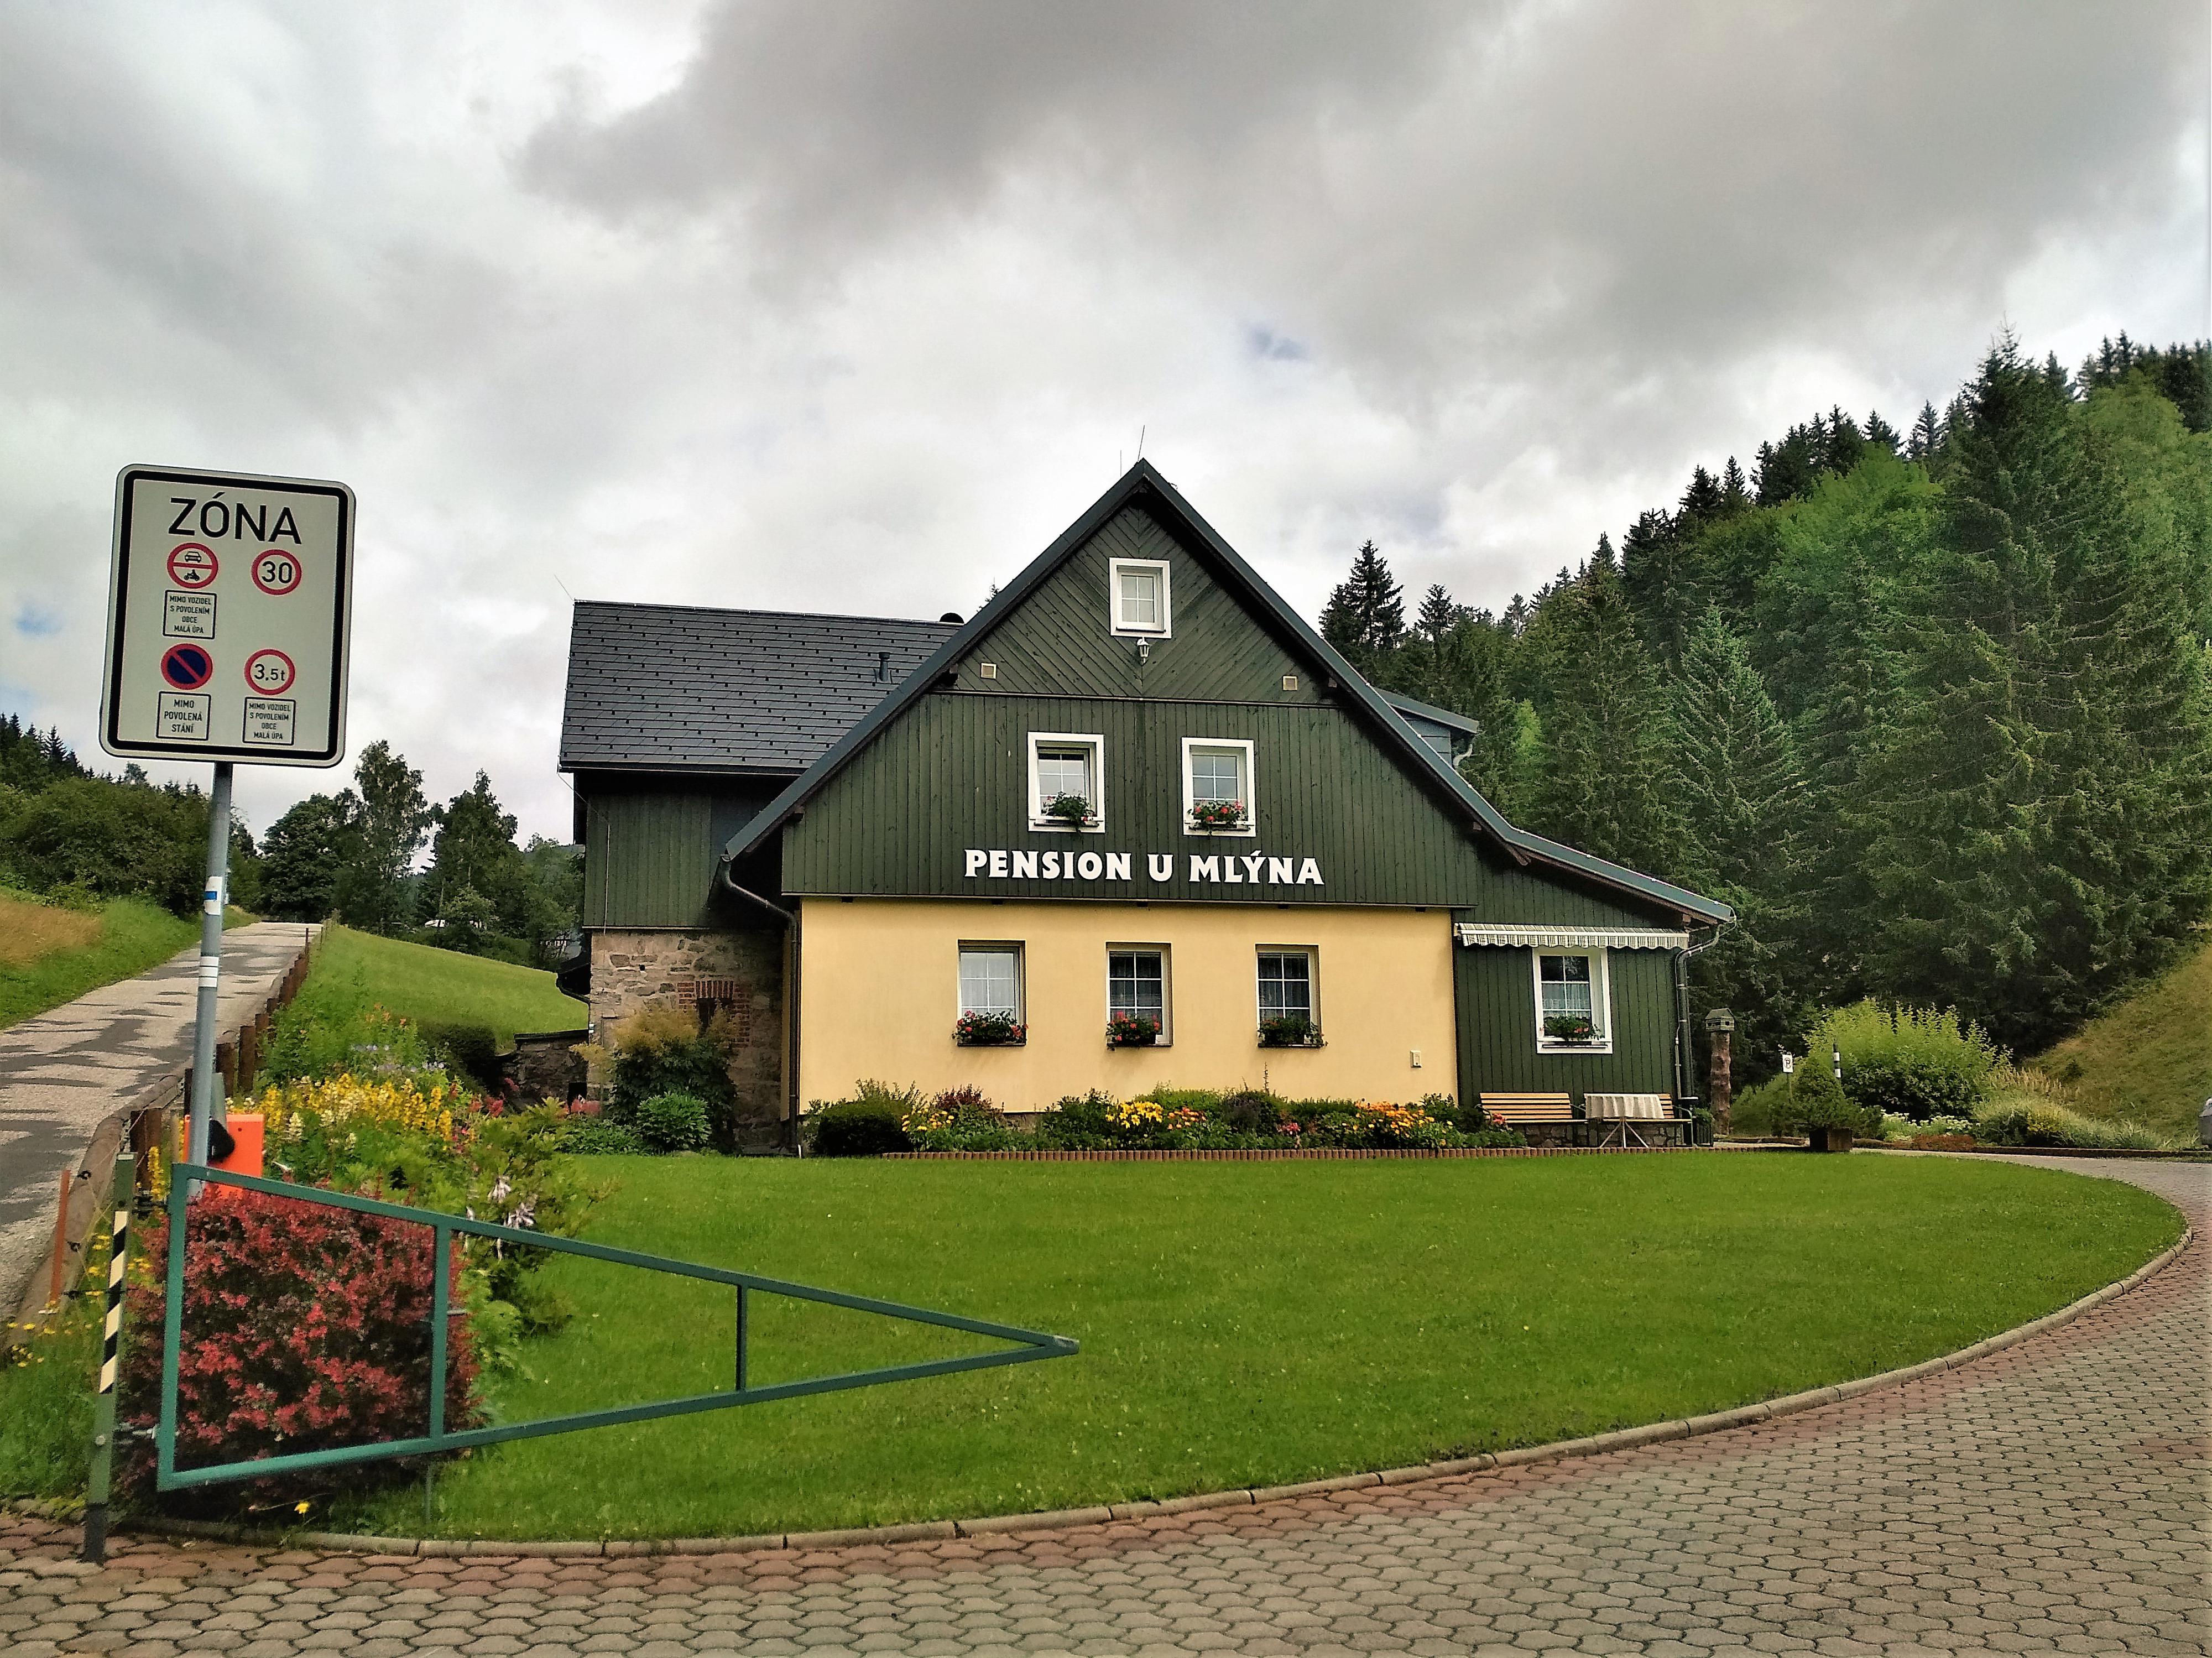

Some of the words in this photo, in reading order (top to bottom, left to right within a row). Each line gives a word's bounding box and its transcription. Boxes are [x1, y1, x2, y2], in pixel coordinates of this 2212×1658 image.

[168, 492, 302, 545] ZÓNA
[262, 561, 292, 583] 30
[192, 625, 204, 633] ÚPA
[174, 700, 194, 708] MIMO
[164, 711, 202, 721] POVOLENÁ
[171, 723, 194, 733] STÁNÍ
[272, 731, 283, 739] ÚPA
[964, 849, 1132, 880] PENSION
[1147, 854, 1173, 882] U
[1189, 851, 1324, 885] MLÝNA
